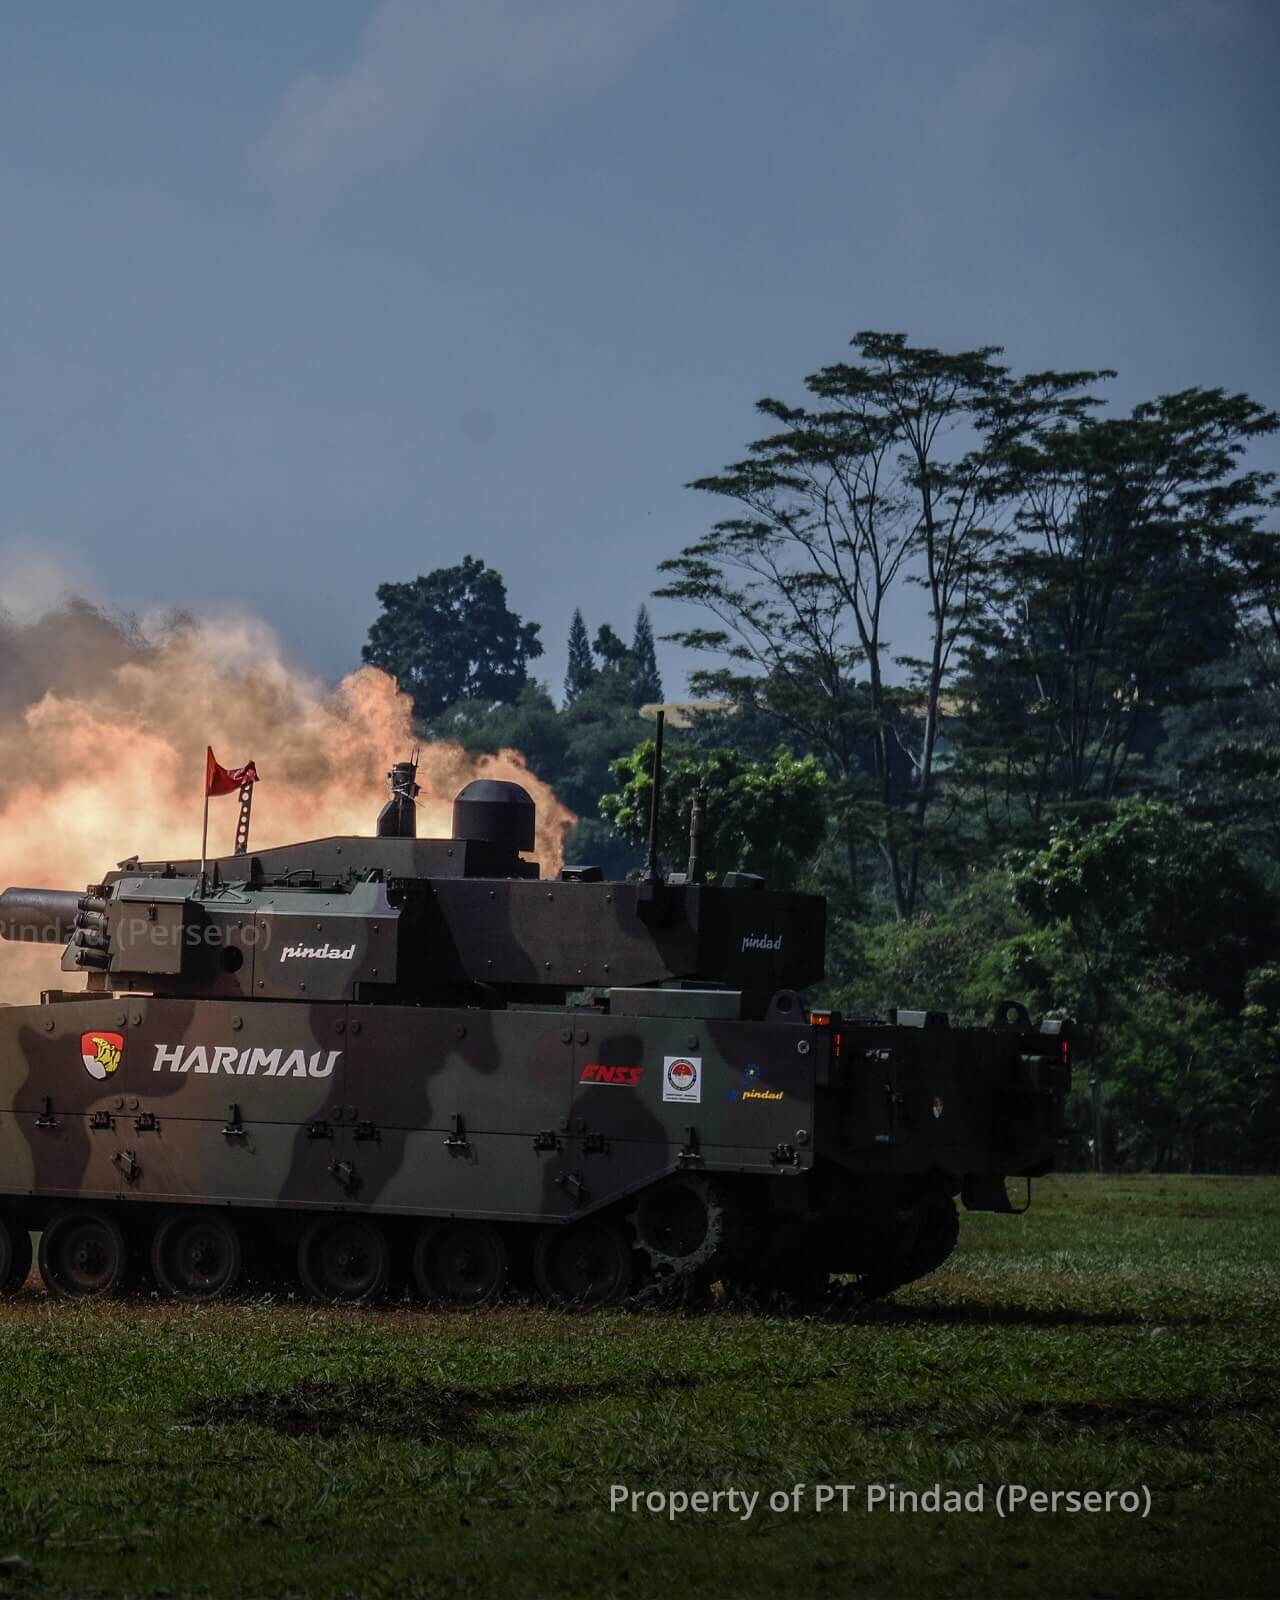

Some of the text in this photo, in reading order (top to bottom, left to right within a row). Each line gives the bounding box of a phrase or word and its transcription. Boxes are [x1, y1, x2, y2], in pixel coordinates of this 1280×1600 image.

[741, 933, 782, 952] pindad
[280, 943, 356, 962] pindad
[152, 1044, 342, 1078] HARIMAU
[580, 1064, 644, 1083] FNSS
[742, 1089, 784, 1101] pindad
